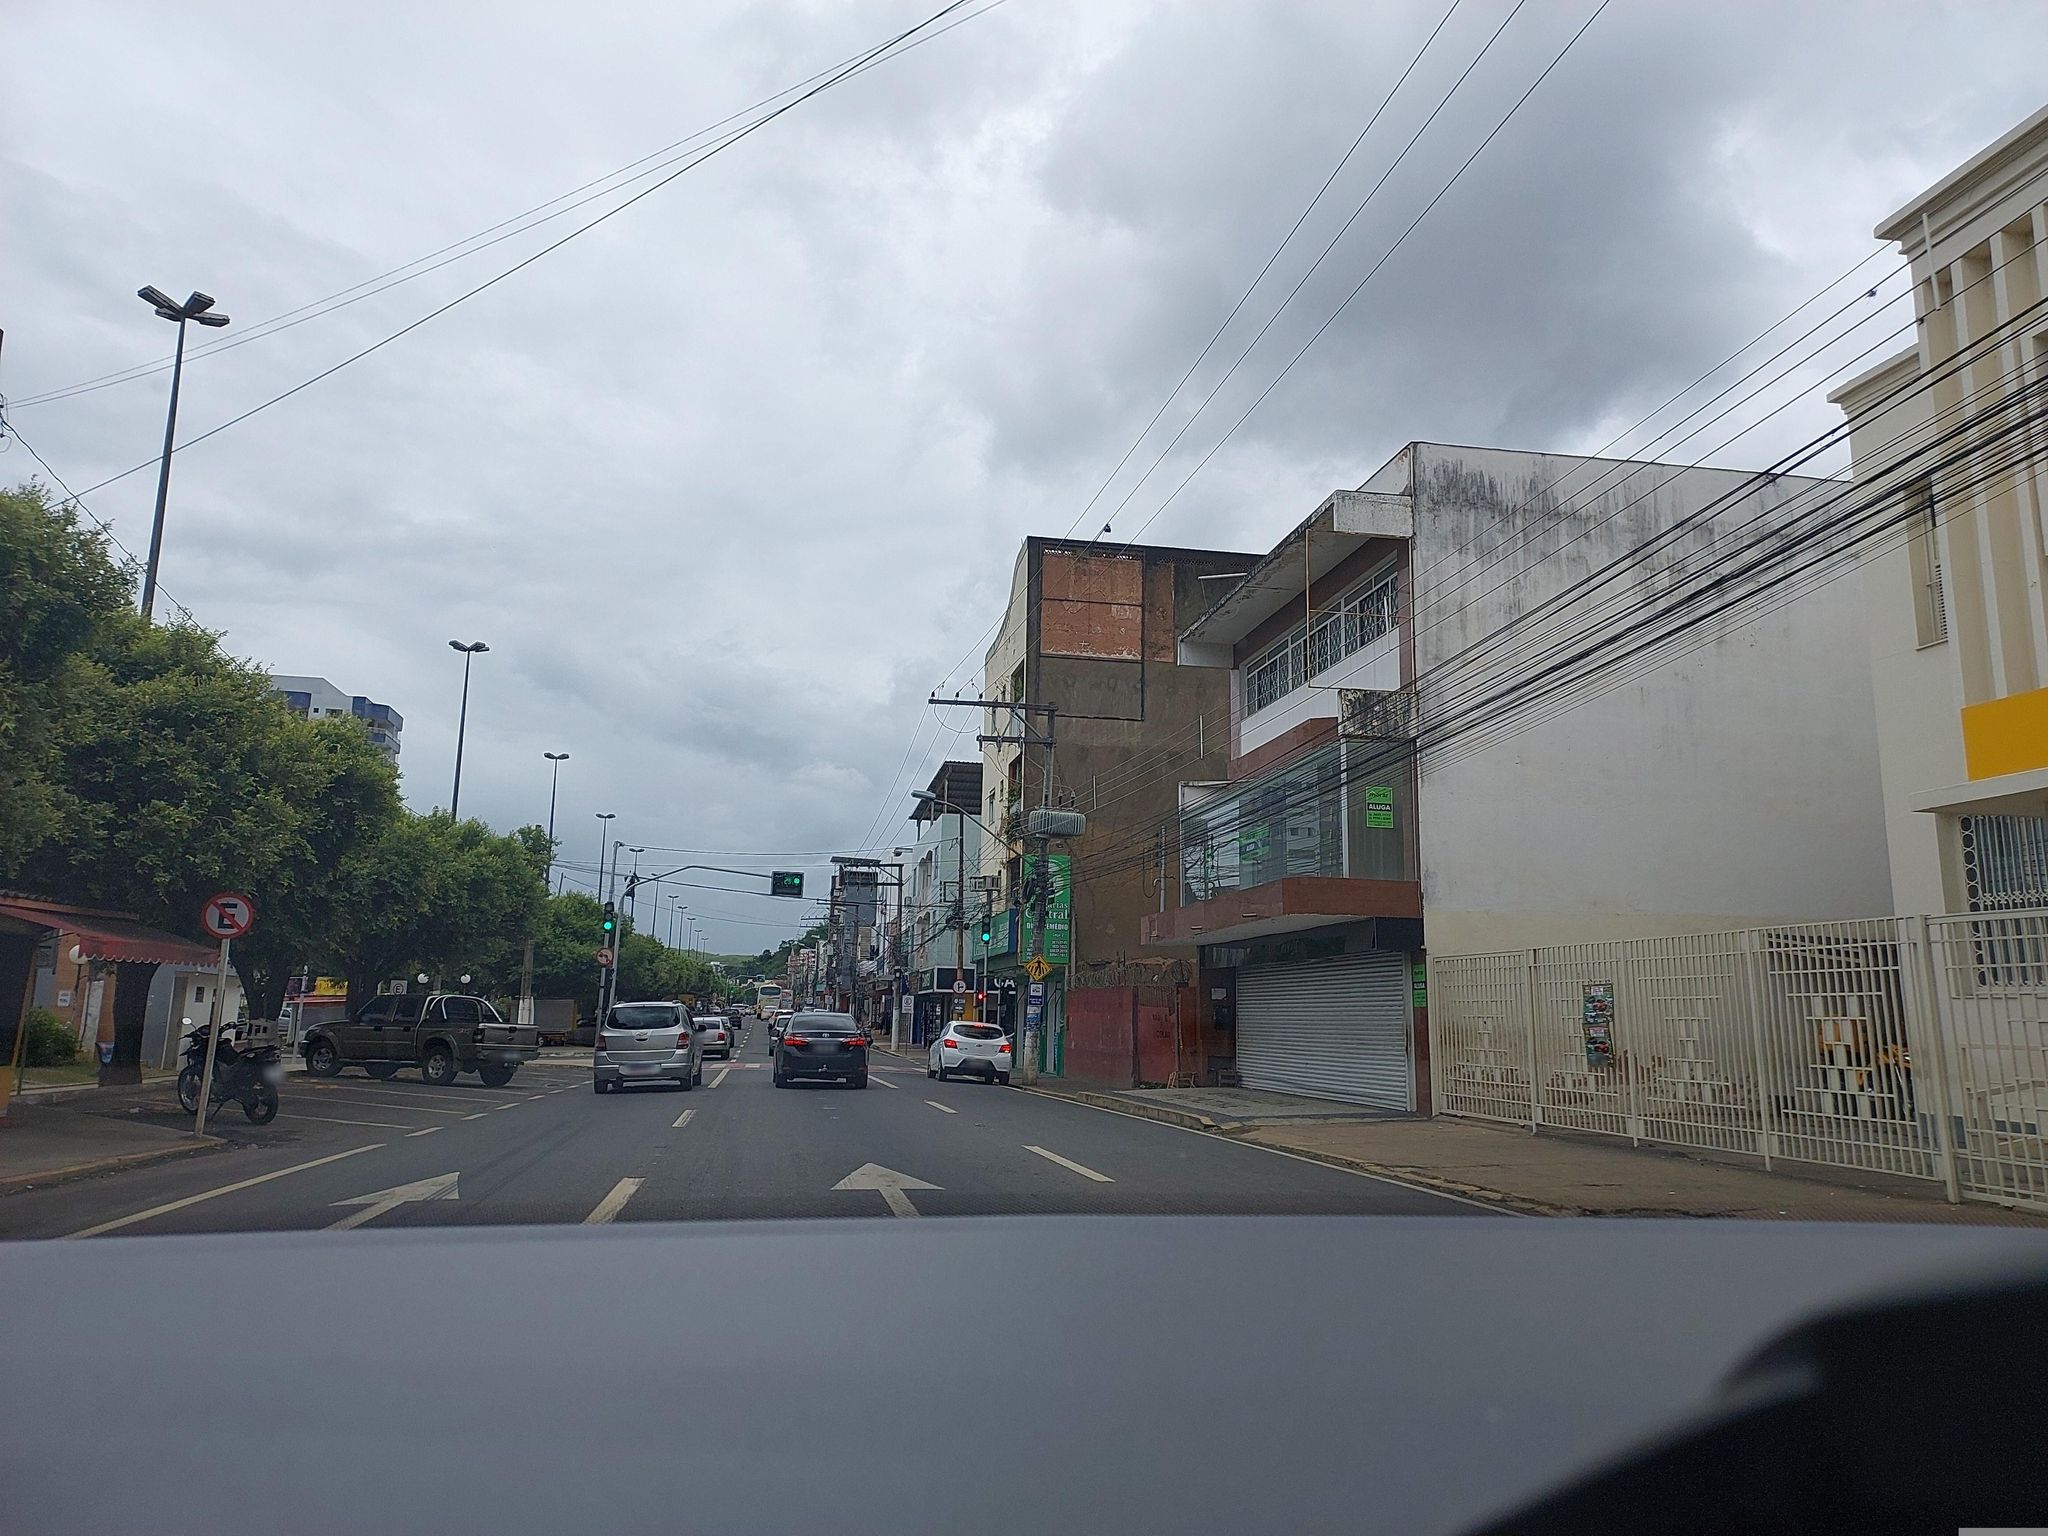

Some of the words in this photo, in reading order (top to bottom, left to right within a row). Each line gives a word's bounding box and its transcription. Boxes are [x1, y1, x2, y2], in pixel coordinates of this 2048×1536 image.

[1368, 803, 1391, 811] ALUGA
[217, 902, 238, 930] E
[1025, 908, 1069, 920] Ctral
